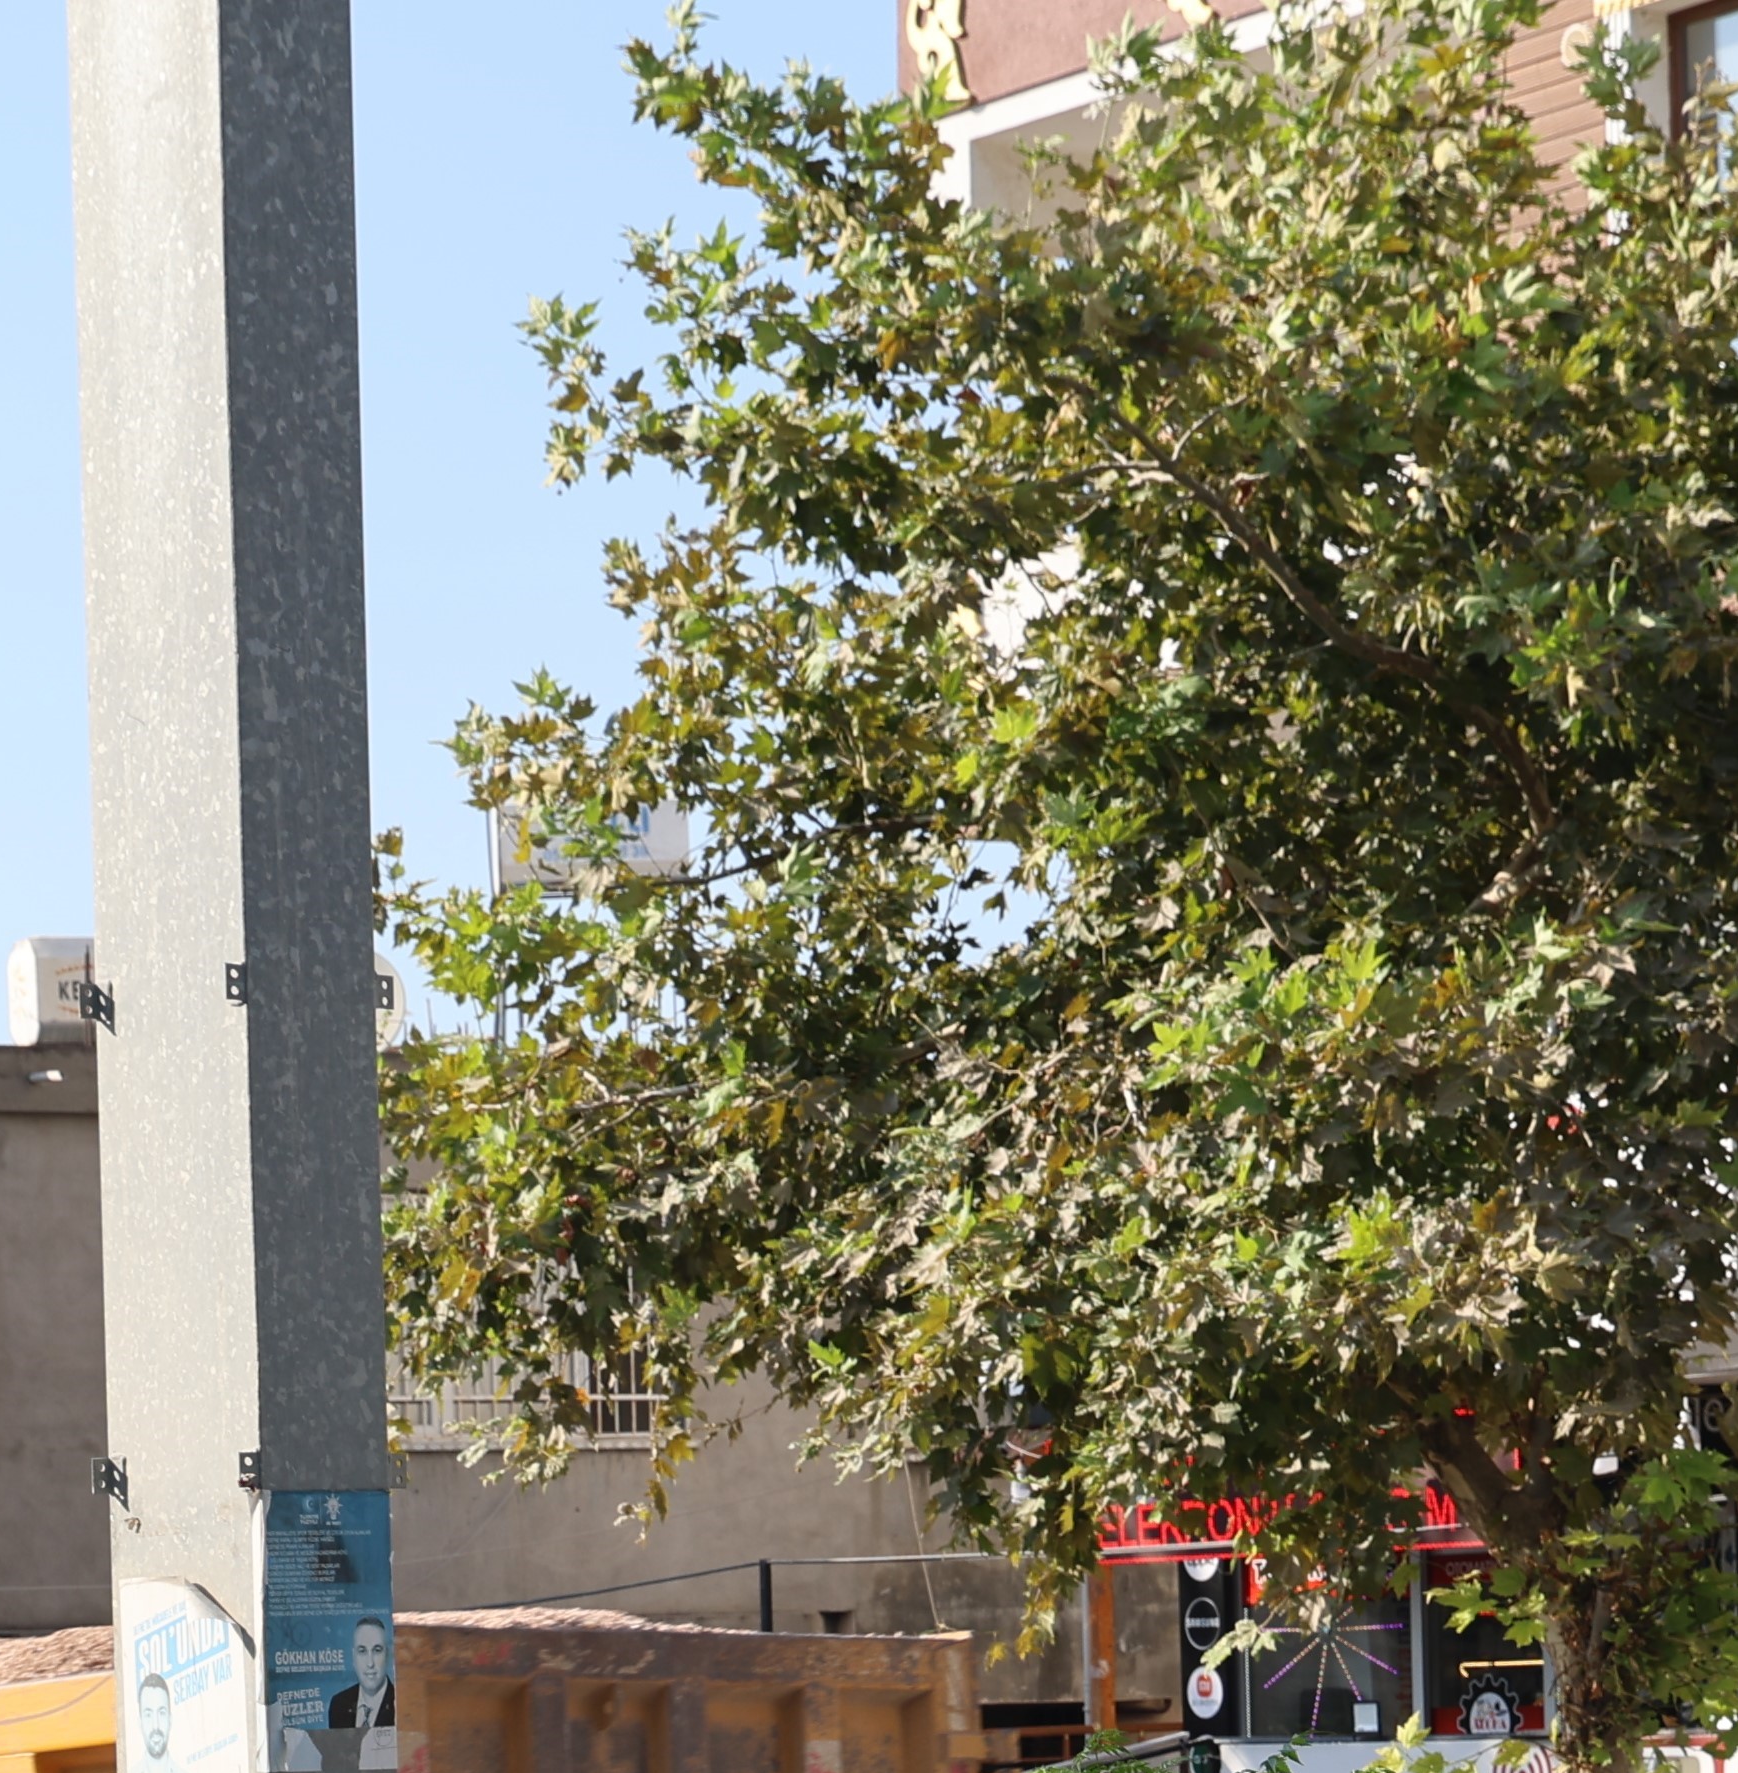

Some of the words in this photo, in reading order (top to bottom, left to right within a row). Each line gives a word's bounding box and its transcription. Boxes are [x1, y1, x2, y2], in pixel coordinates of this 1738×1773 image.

[139, 1618, 226, 1681] SOL'UNDA
[275, 1649, 317, 1665] GÖKHAN
[318, 1648, 344, 1664] KÖSE
[173, 1664, 209, 1706] SERBAY
[212, 1653, 233, 1686] VAR
[277, 1687, 321, 1701] DEFNE'DE
[282, 1700, 325, 1717] ÜZLER
